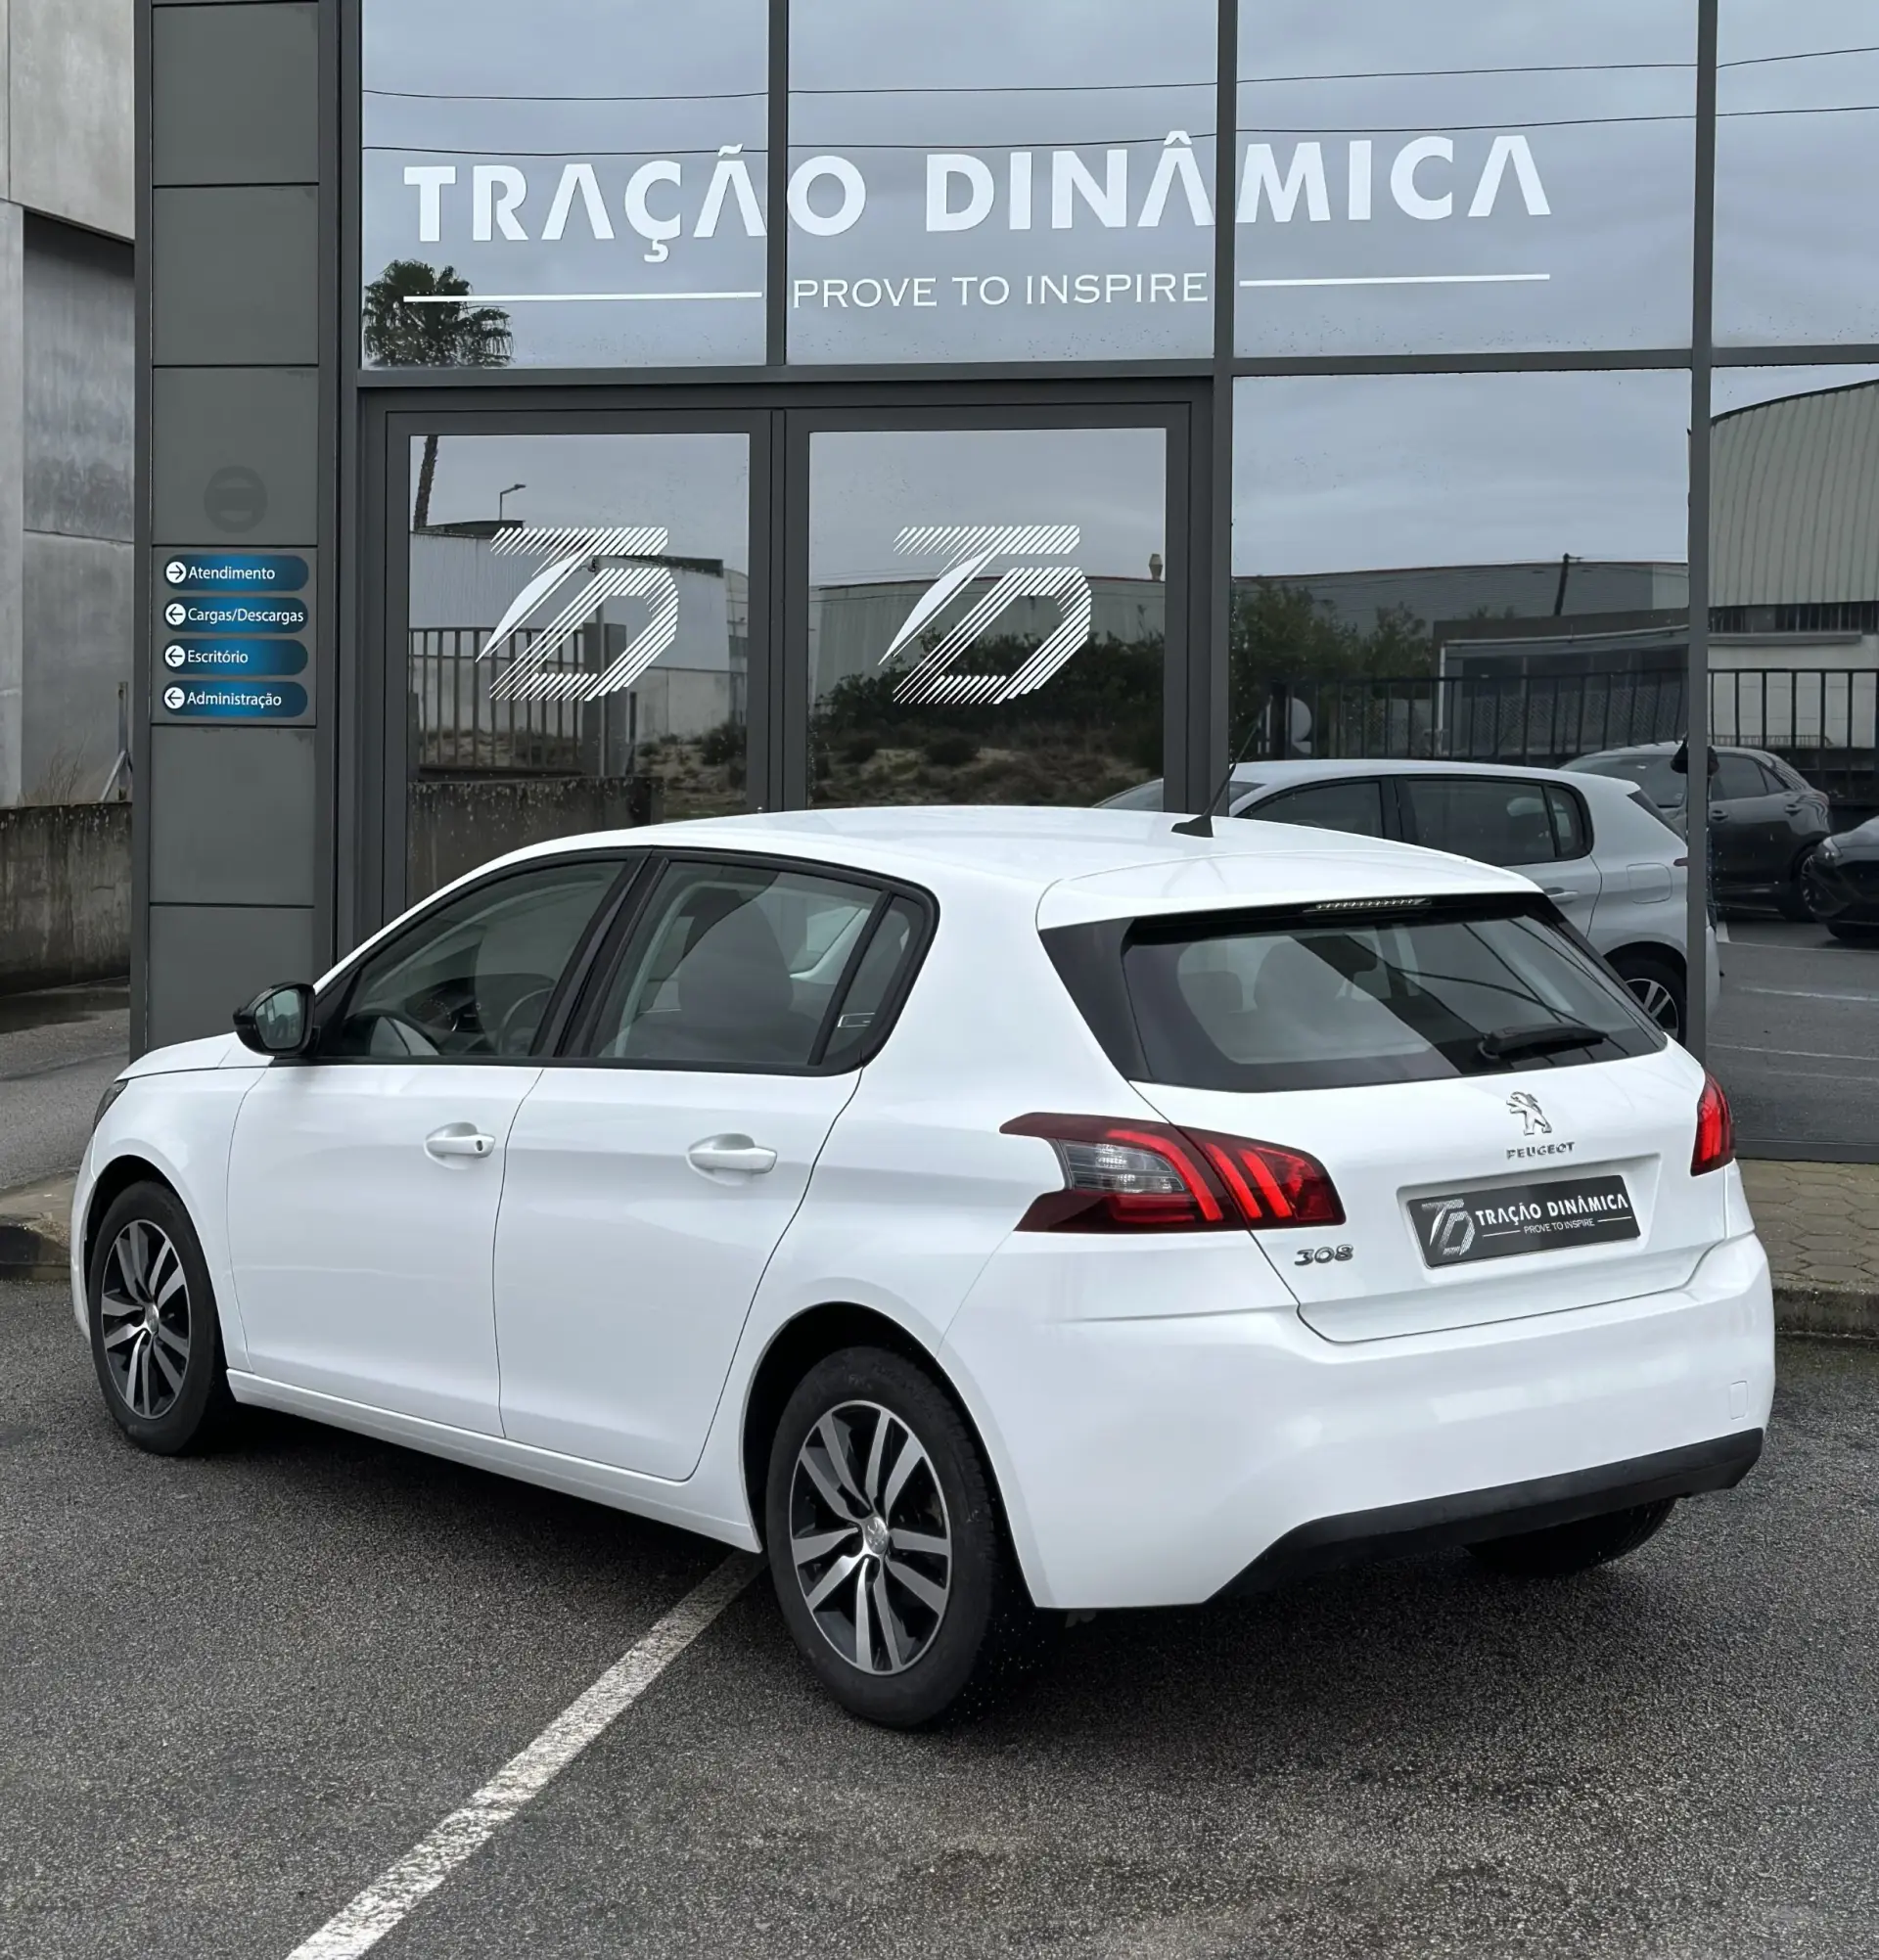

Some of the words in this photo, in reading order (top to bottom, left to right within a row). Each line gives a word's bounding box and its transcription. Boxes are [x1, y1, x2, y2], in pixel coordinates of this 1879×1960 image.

[403, 144, 866, 262] TRAÇÃO
[926, 130, 1551, 232] DINÂMICA
[793, 278, 937, 308] PROVE
[951, 276, 1010, 305] TO
[1026, 272, 1209, 304] INSPIRE
[188, 566, 276, 580] Atendimento
[188, 608, 303, 625] Cargas/Descargas
[187, 650, 249, 663] Escritório
[187, 692, 282, 708] Administração
[1506, 1141, 1575, 1160] PEUGEOT
[1475, 1203, 1541, 1225] TRAÇÃO
[1546, 1193, 1628, 1216] DINÂMICA
[1523, 1223, 1552, 1235] PROVE
[1552, 1222, 1564, 1232] TO
[1565, 1217, 1595, 1230] INSPIRE
[1294, 1244, 1353, 1266] 308
